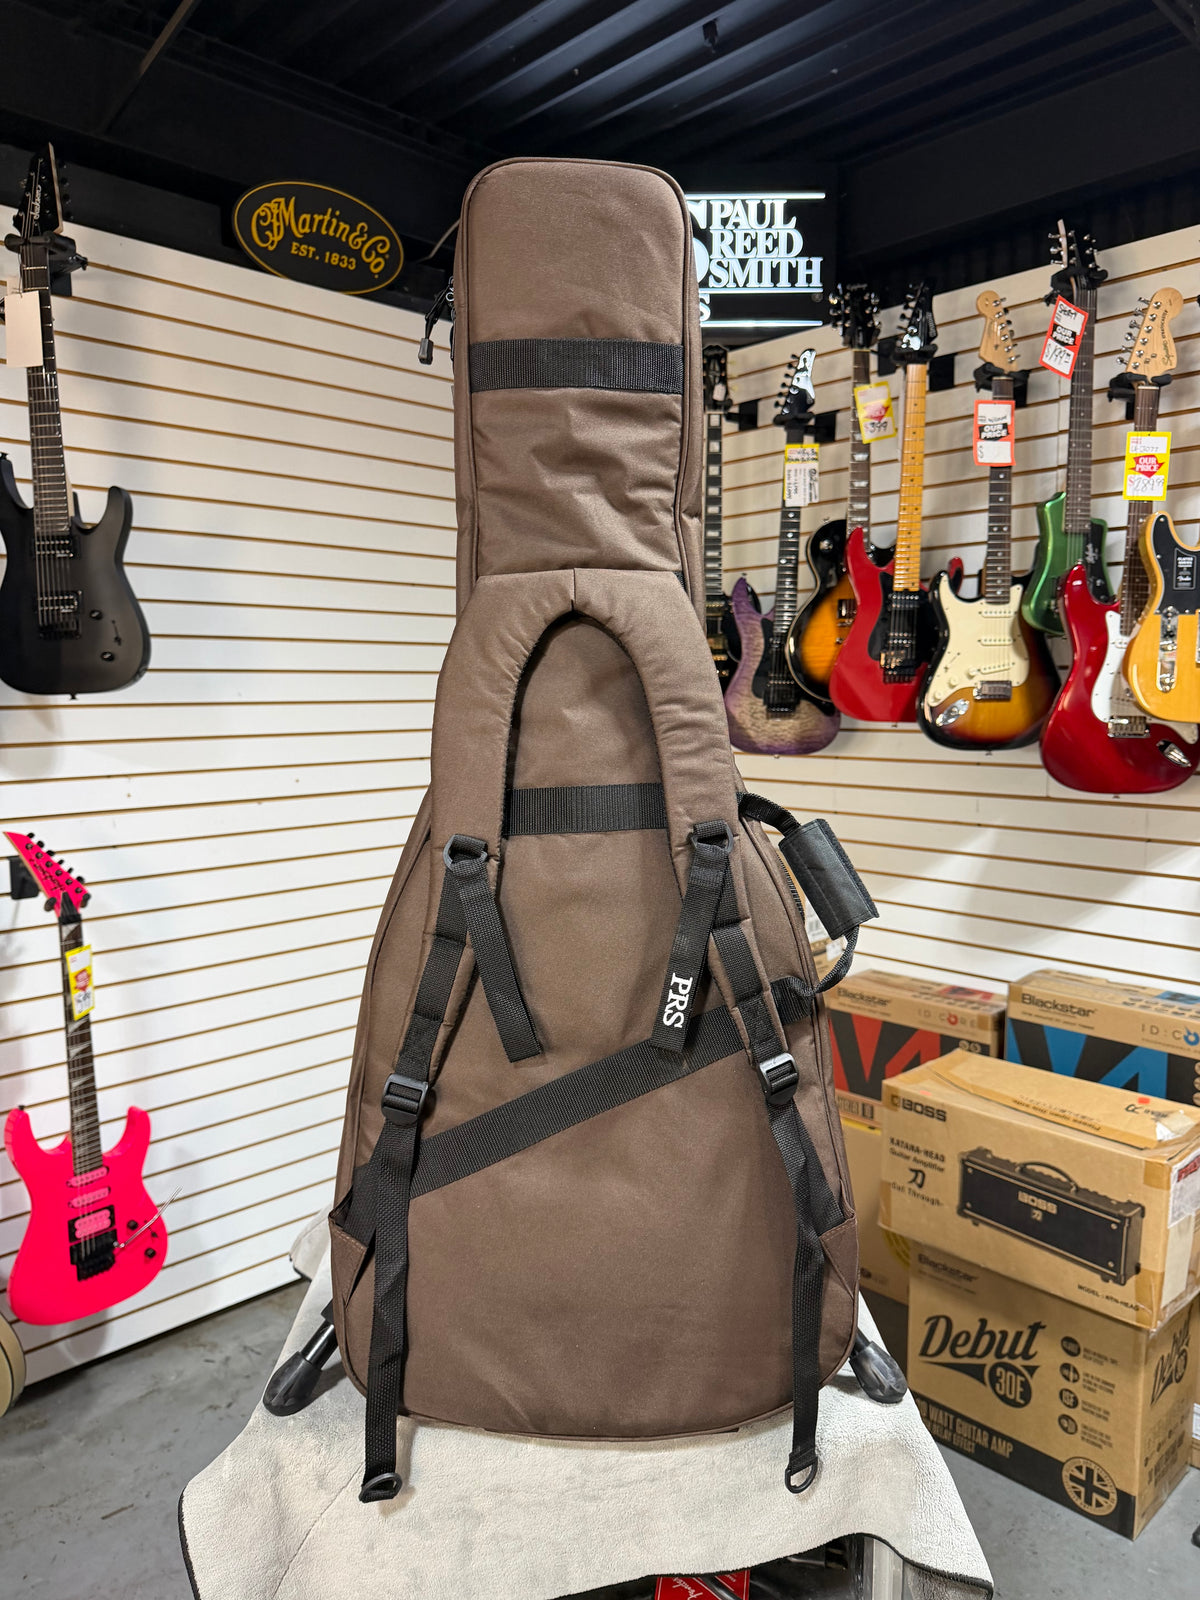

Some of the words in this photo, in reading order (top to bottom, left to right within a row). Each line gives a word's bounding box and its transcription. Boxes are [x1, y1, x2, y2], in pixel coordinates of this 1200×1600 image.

[709, 199, 797, 230] PAUL
[291, 241, 319, 260] EST.
[324, 251, 356, 270] 1833
[709, 229, 804, 259] REED
[708, 257, 823, 288] SMITH
[1135, 463, 1160, 472] PRICE
[1138, 456, 1157, 464] OUR
[663, 972, 693, 1028] PRS
[837, 986, 889, 1006] Blackstar
[1021, 992, 1095, 1018] Blackstar
[901, 1097, 947, 1122] BOSS
[1017, 1190, 1059, 1216] BOSS
[919, 1315, 1047, 1361] Debut
[995, 1366, 1026, 1405] 30E
[929, 1403, 955, 1431] WATT
[955, 1418, 990, 1449] GUITAR
[990, 1435, 1014, 1459] AMP
